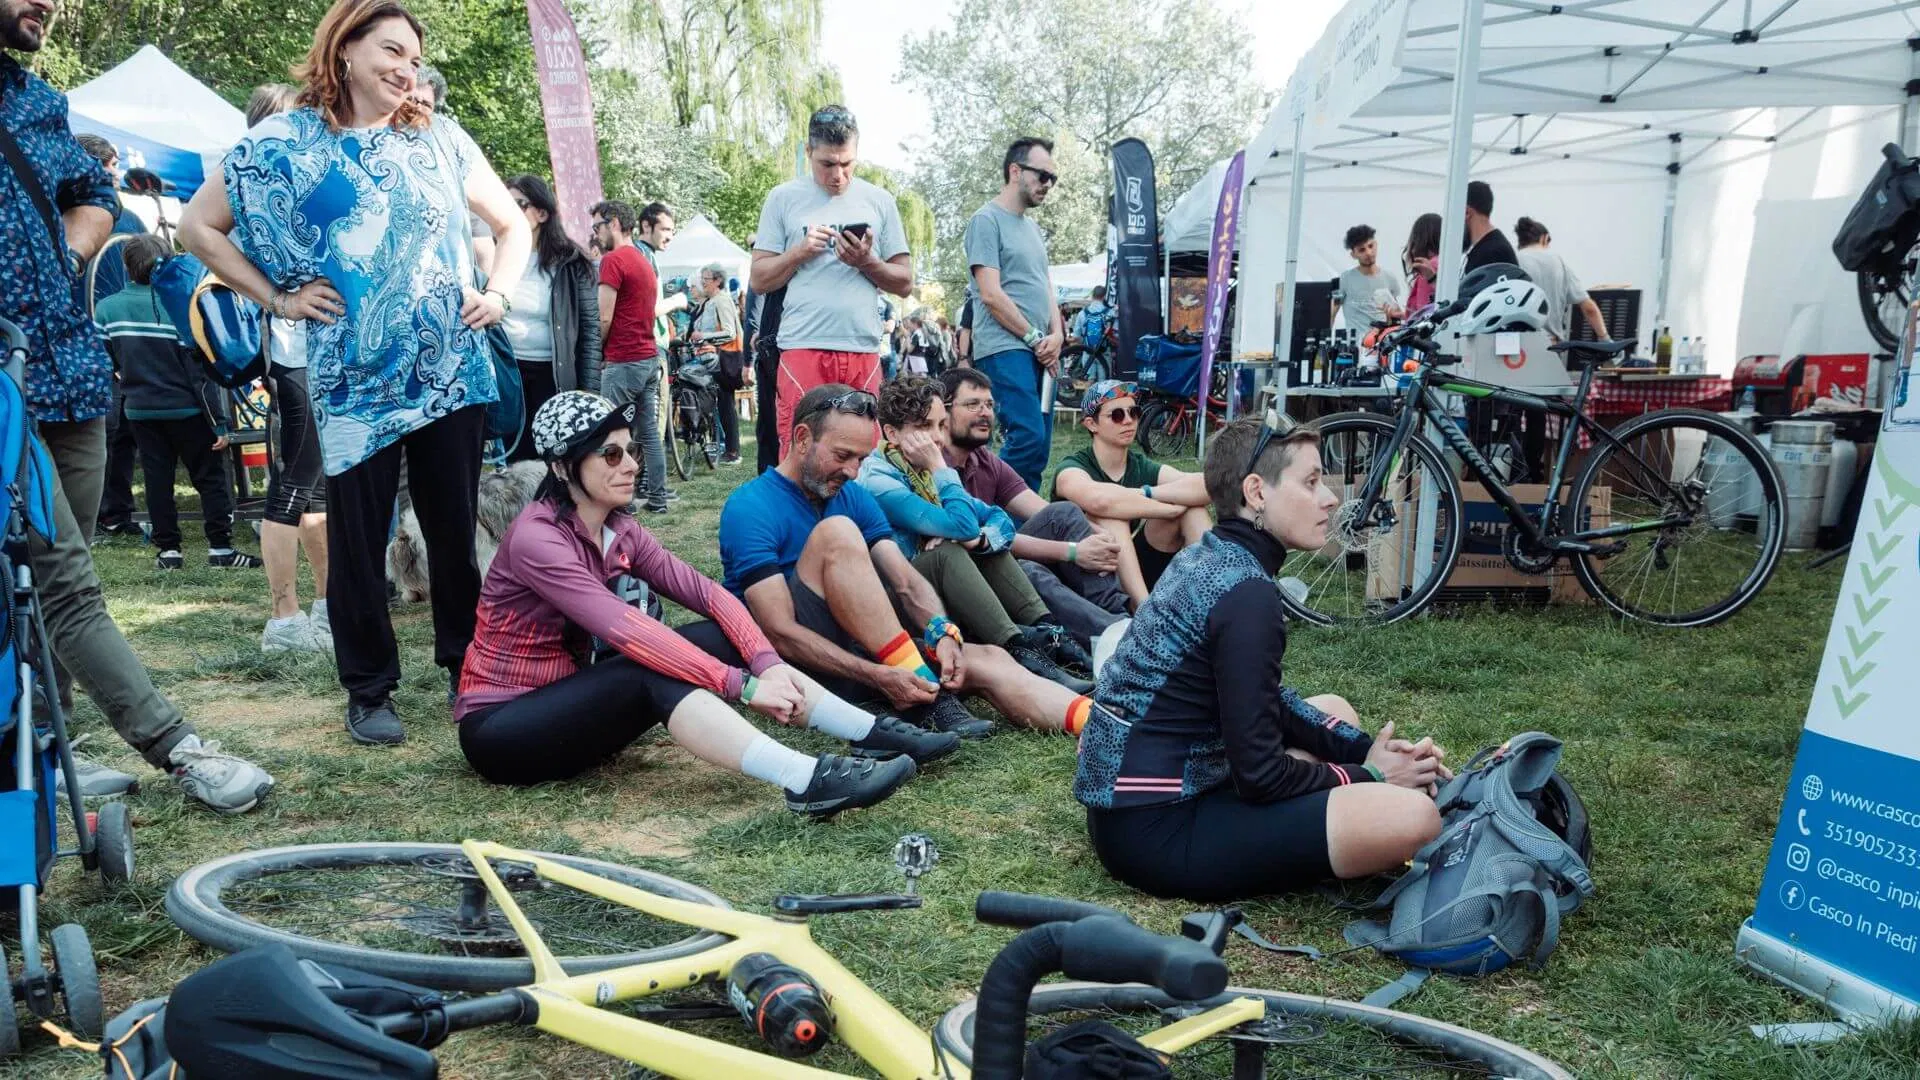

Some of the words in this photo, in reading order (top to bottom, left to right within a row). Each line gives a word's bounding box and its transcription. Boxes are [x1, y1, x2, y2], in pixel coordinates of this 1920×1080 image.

[1830, 788, 1920, 829] www.casco
[1823, 820, 1920, 870] 351905233
[1817, 857, 1920, 911] @casco_inpi
[1808, 896, 1853, 928] Casco
[1856, 914, 1873, 936] In
[1875, 921, 1918, 955] Piedi
